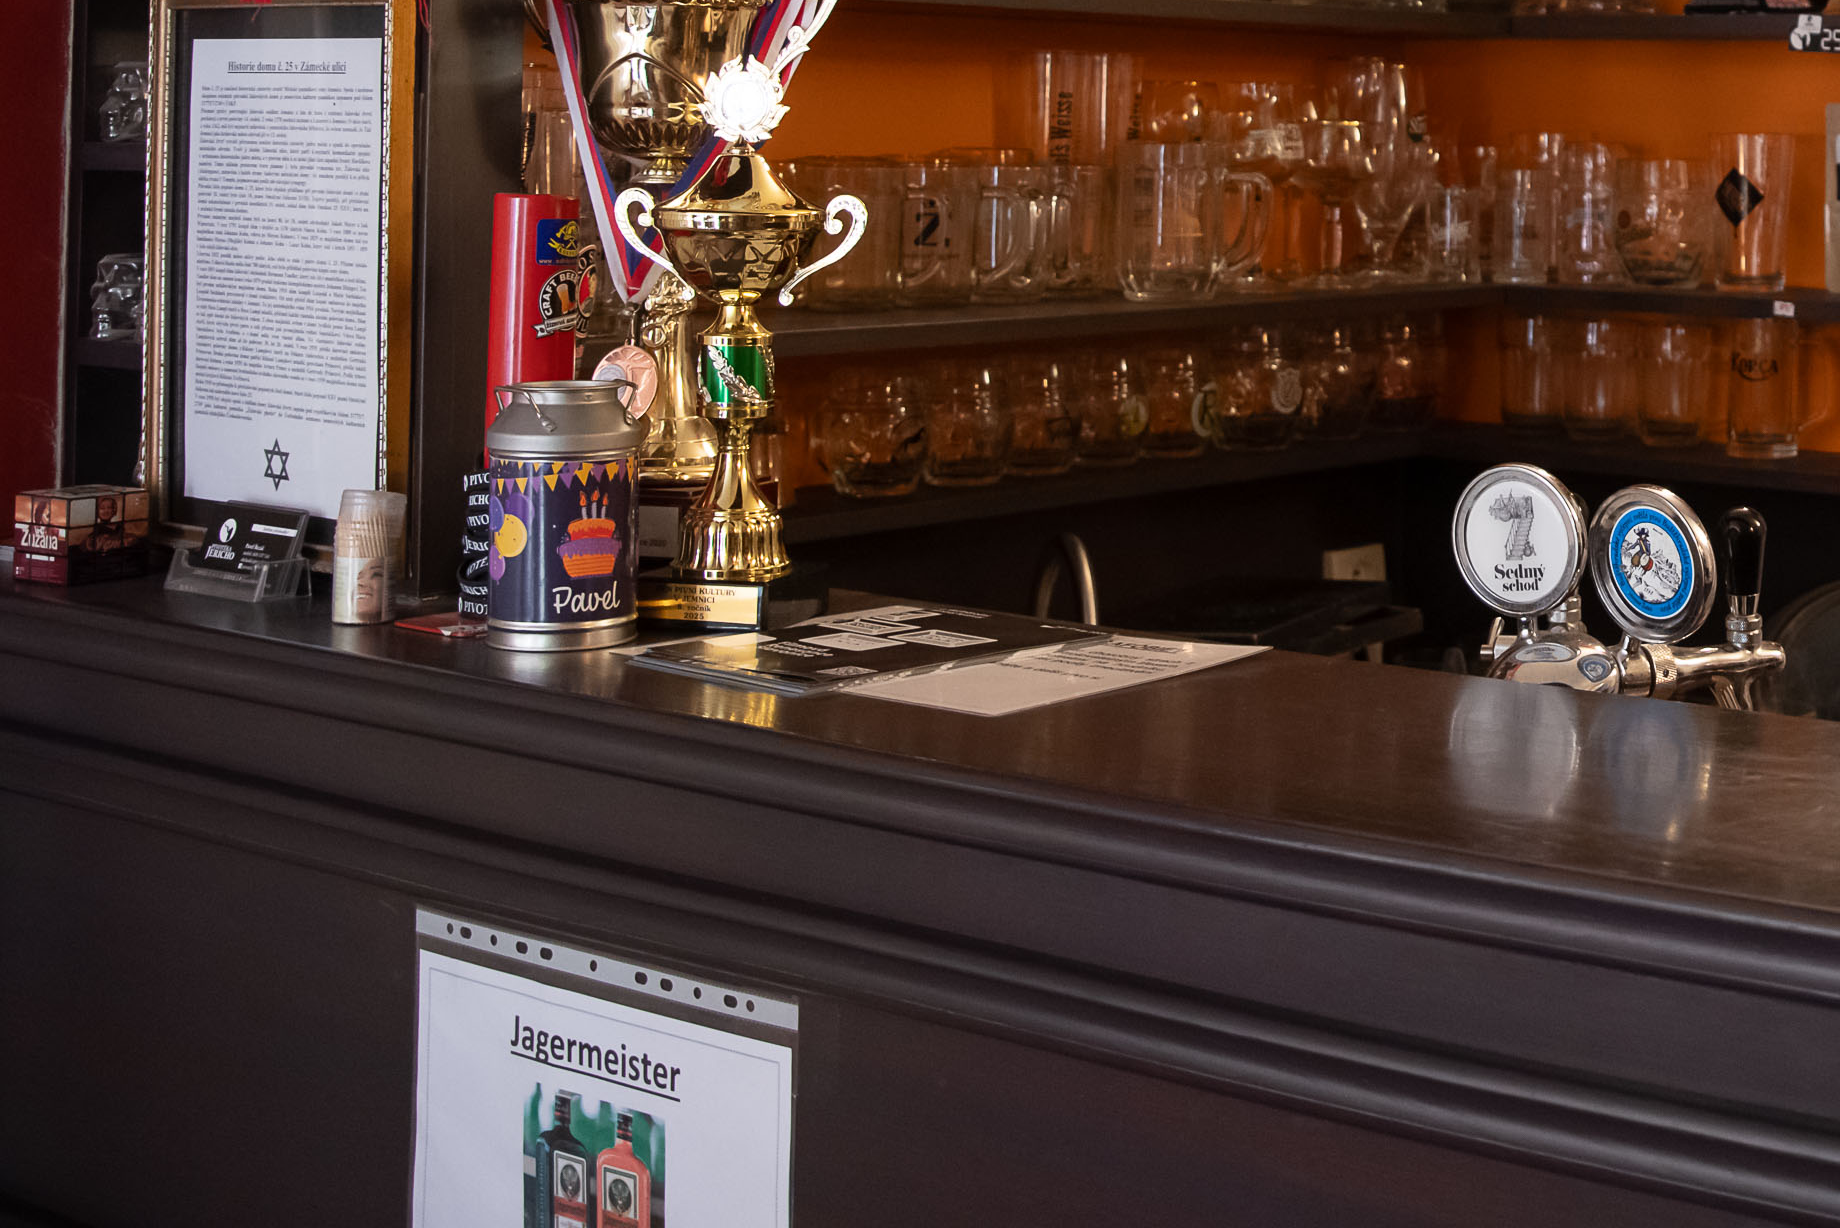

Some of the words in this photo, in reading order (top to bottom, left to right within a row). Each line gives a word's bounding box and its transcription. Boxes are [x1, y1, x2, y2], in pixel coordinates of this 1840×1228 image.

[542, 277, 557, 316] CRAFT
[21, 528, 58, 551] Zuzana
[204, 546, 235, 560] JERICHO
[1494, 563, 1546, 581] Sedmý
[1502, 578, 1539, 592] schod
[552, 581, 621, 614] Pavel
[510, 1015, 681, 1092] Jagermeister
